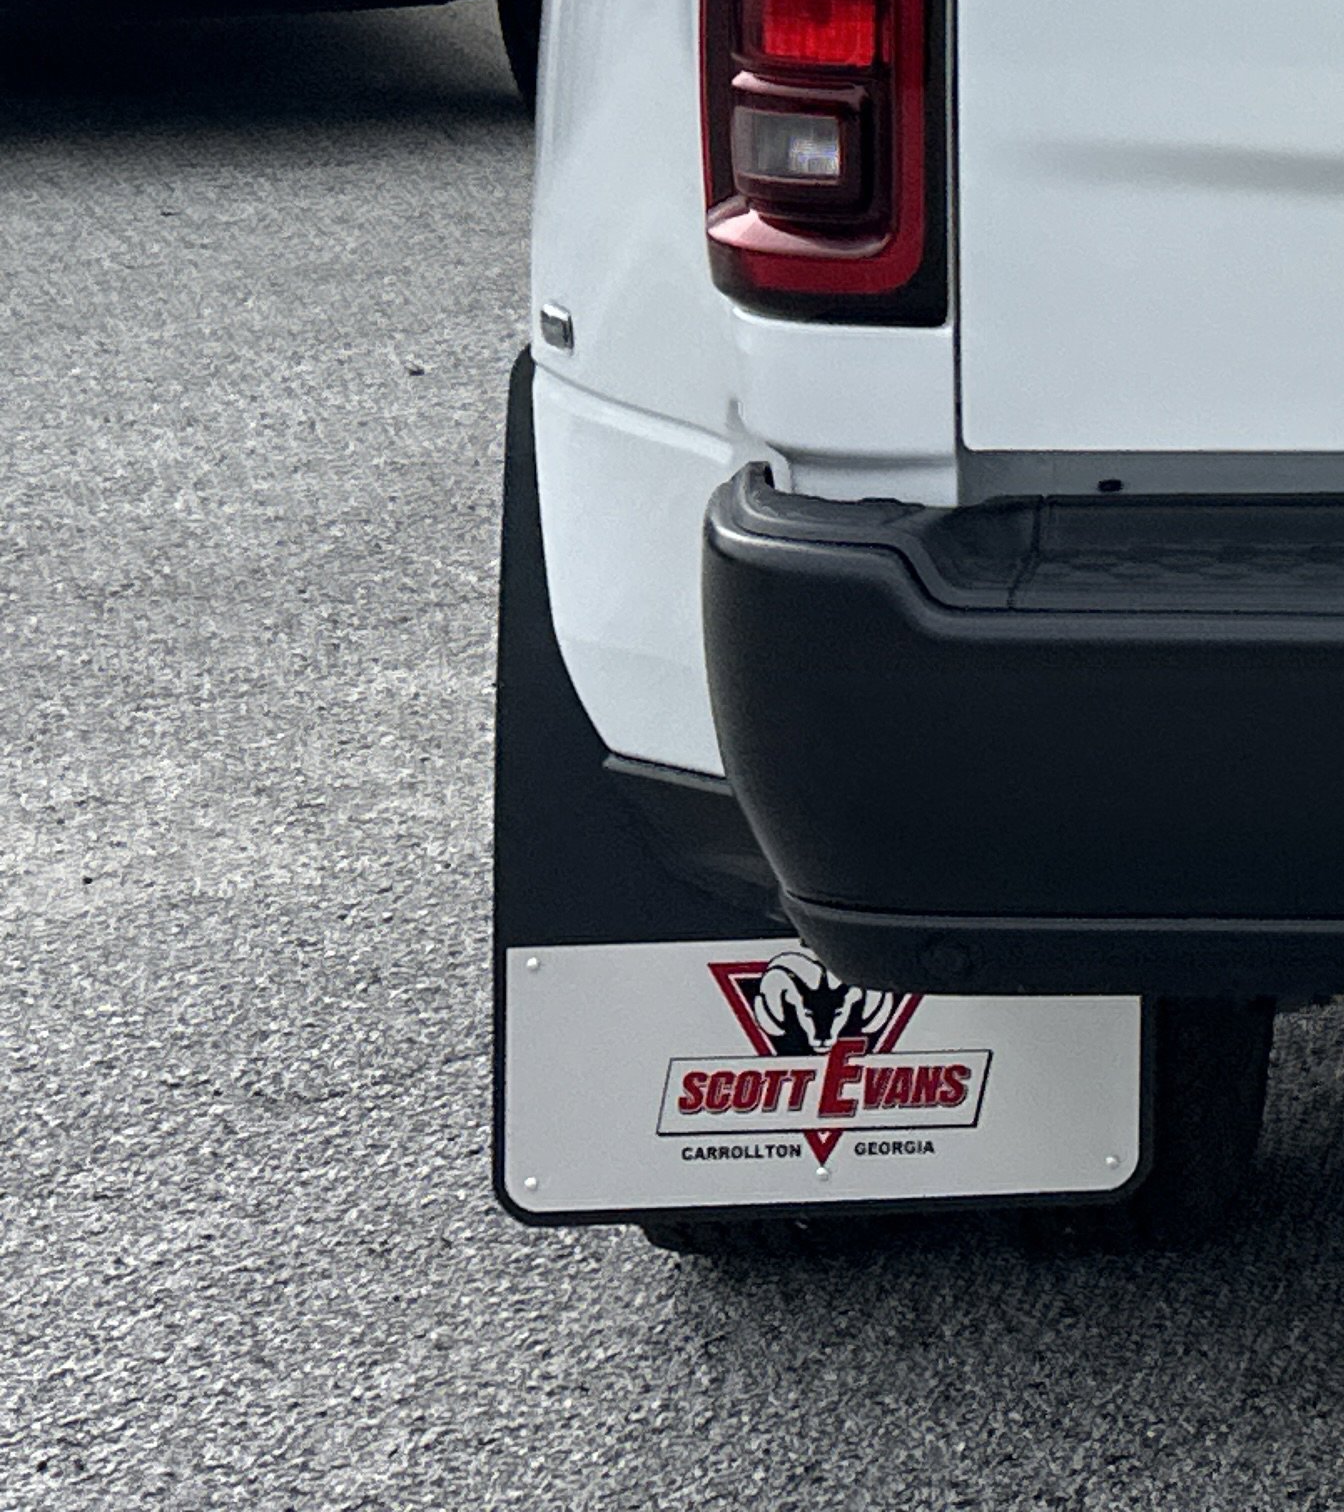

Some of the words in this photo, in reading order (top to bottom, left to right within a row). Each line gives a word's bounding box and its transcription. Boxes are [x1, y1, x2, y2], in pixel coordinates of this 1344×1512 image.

[678, 1068, 816, 1114] SCOTT
[818, 1037, 971, 1118] EVANS
[681, 1144, 801, 1161] CARROLLTON
[854, 1141, 935, 1156] GEORGIA
